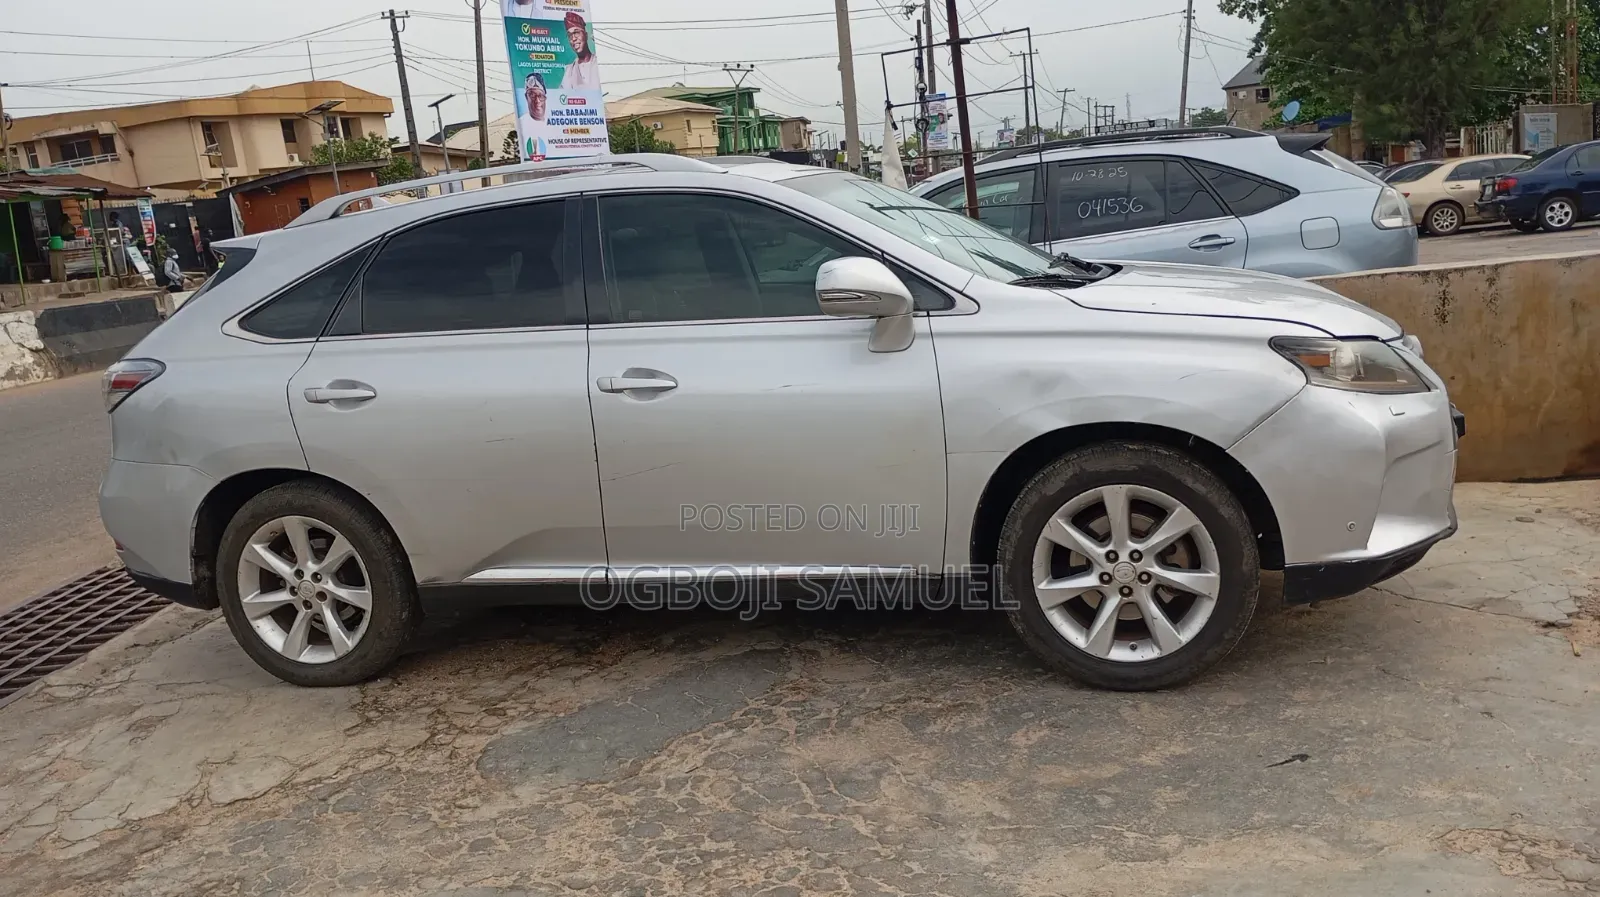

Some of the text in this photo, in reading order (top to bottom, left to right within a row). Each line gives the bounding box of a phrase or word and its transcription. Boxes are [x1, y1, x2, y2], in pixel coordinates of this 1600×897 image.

[532, 36, 560, 44] MUKHAIL
[515, 43, 545, 51] TOKUNBO
[1077, 197, 1144, 219] 041536
